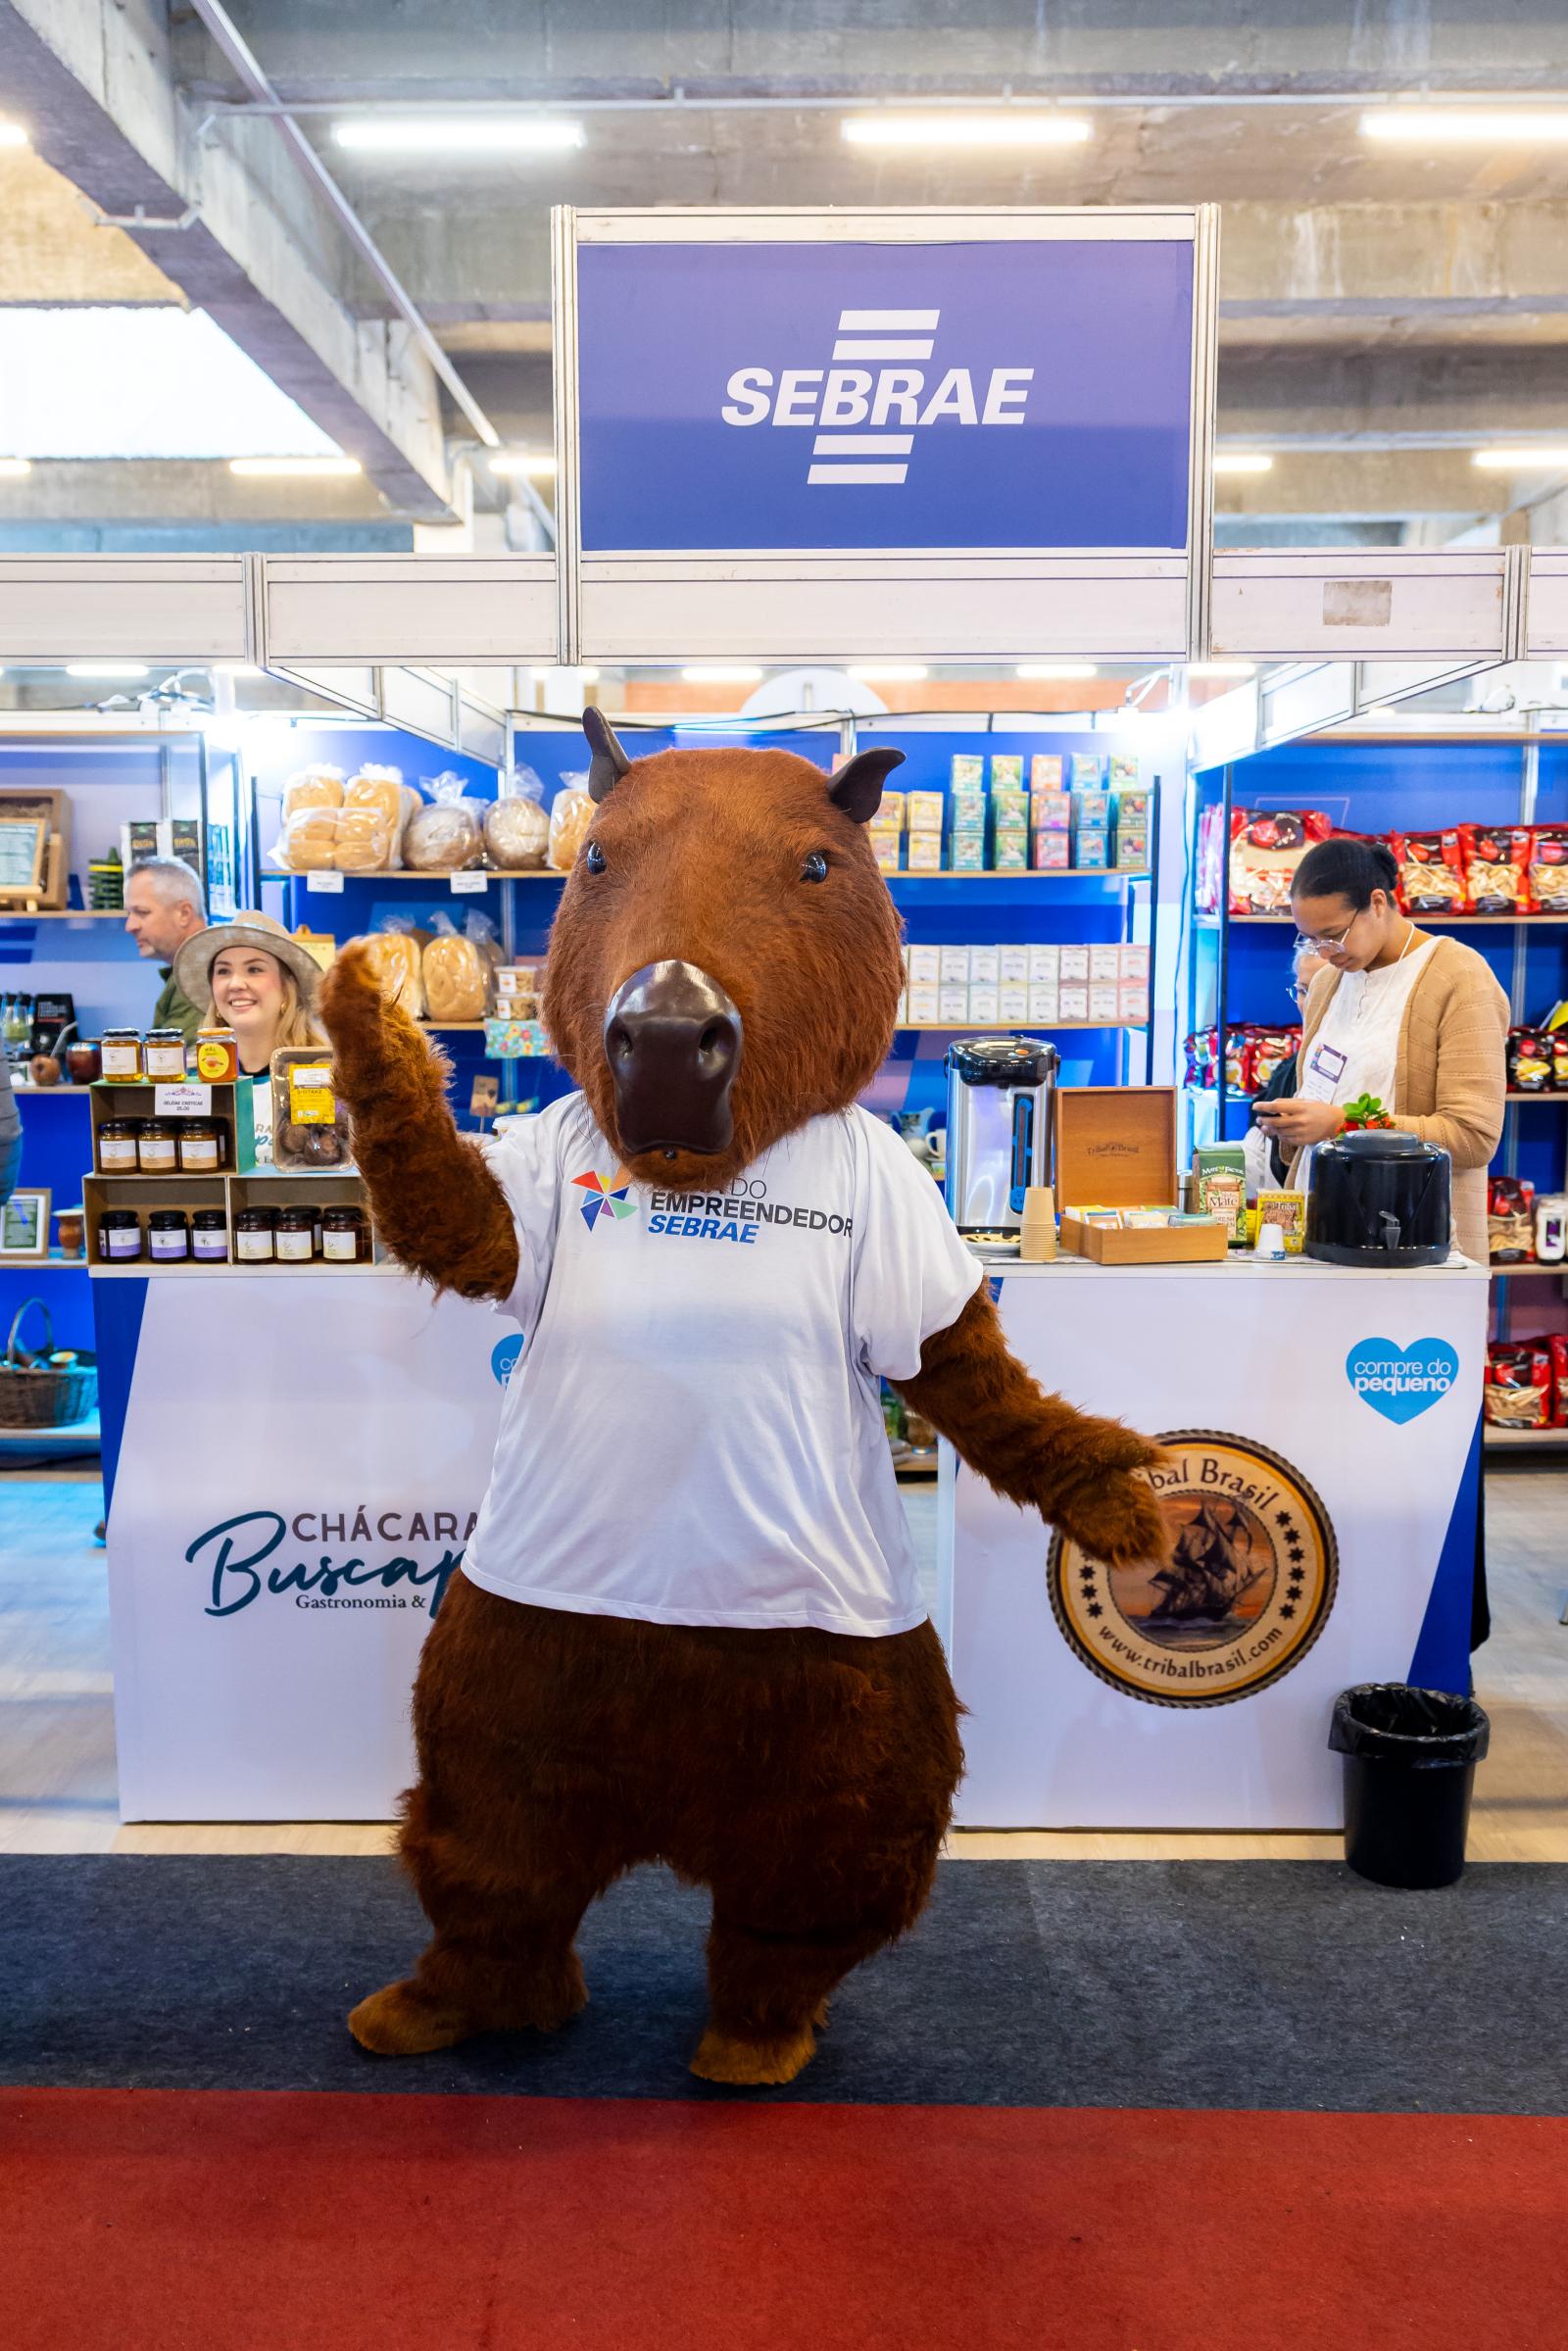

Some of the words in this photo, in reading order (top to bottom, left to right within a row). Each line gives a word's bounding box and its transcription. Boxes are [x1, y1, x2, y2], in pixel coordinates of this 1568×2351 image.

[721, 367, 1034, 426] SEBRAE
[731, 1177, 767, 1200] DO
[1209, 1196, 1238, 1206] Mate
[648, 1214, 760, 1245] SEBRAE
[650, 1192, 853, 1239] EMPREENDEDOR
[1354, 1361, 1423, 1377] compre
[1427, 1358, 1451, 1375] do
[1354, 1376, 1451, 1396] pequeno
[1200, 1458, 1280, 1512] Brasil
[185, 1510, 466, 1619] Buscap
[295, 1594, 407, 1609] Gastronomia
[412, 1595, 426, 1608] &
[1100, 1625, 1283, 1679] www.tribalbrasil.com
